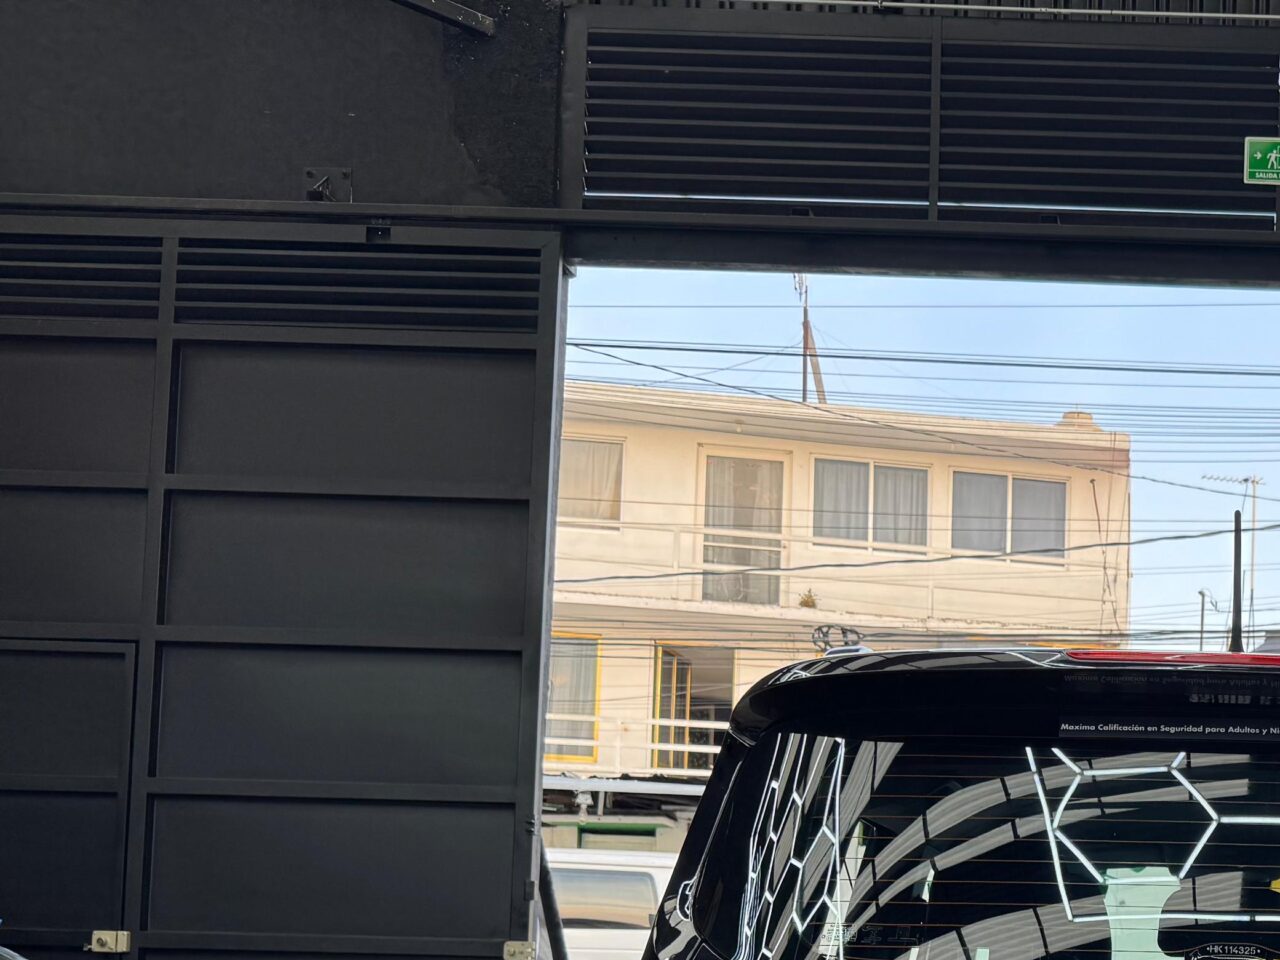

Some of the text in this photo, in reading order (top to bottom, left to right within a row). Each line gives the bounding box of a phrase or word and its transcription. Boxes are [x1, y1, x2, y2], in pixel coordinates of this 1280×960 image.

[1060, 723, 1096, 731] Maxima
[1097, 723, 1145, 733] Calificación
[1159, 724, 1203, 734] Seguridad
[1205, 727, 1227, 735] para
[1228, 726, 1259, 735] Adultos
